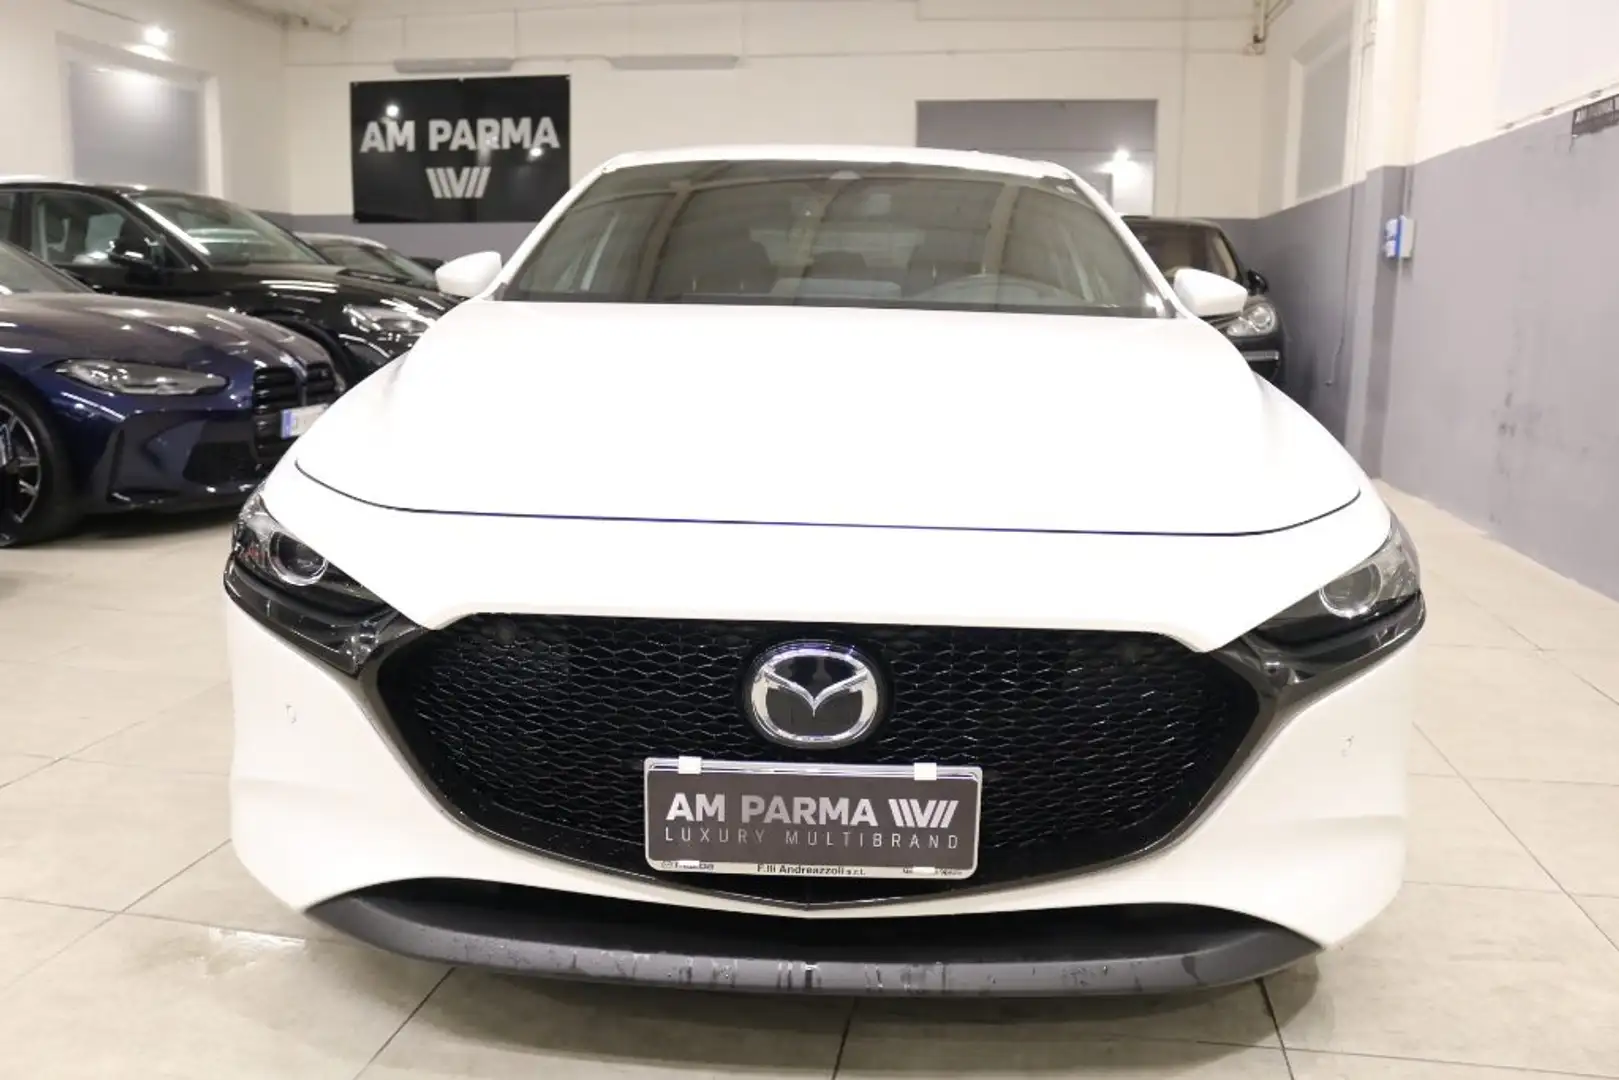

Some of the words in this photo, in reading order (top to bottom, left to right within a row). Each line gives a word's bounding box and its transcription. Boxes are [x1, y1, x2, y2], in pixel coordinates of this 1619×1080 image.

[359, 120, 416, 153] AM
[428, 116, 561, 151] PARMA
[665, 793, 725, 822] AM
[741, 795, 879, 827] PARMA
[665, 826, 765, 844] LUXURY
[785, 831, 958, 849] MULTIBRAND
[779, 864, 844, 875] Andreazzoli
